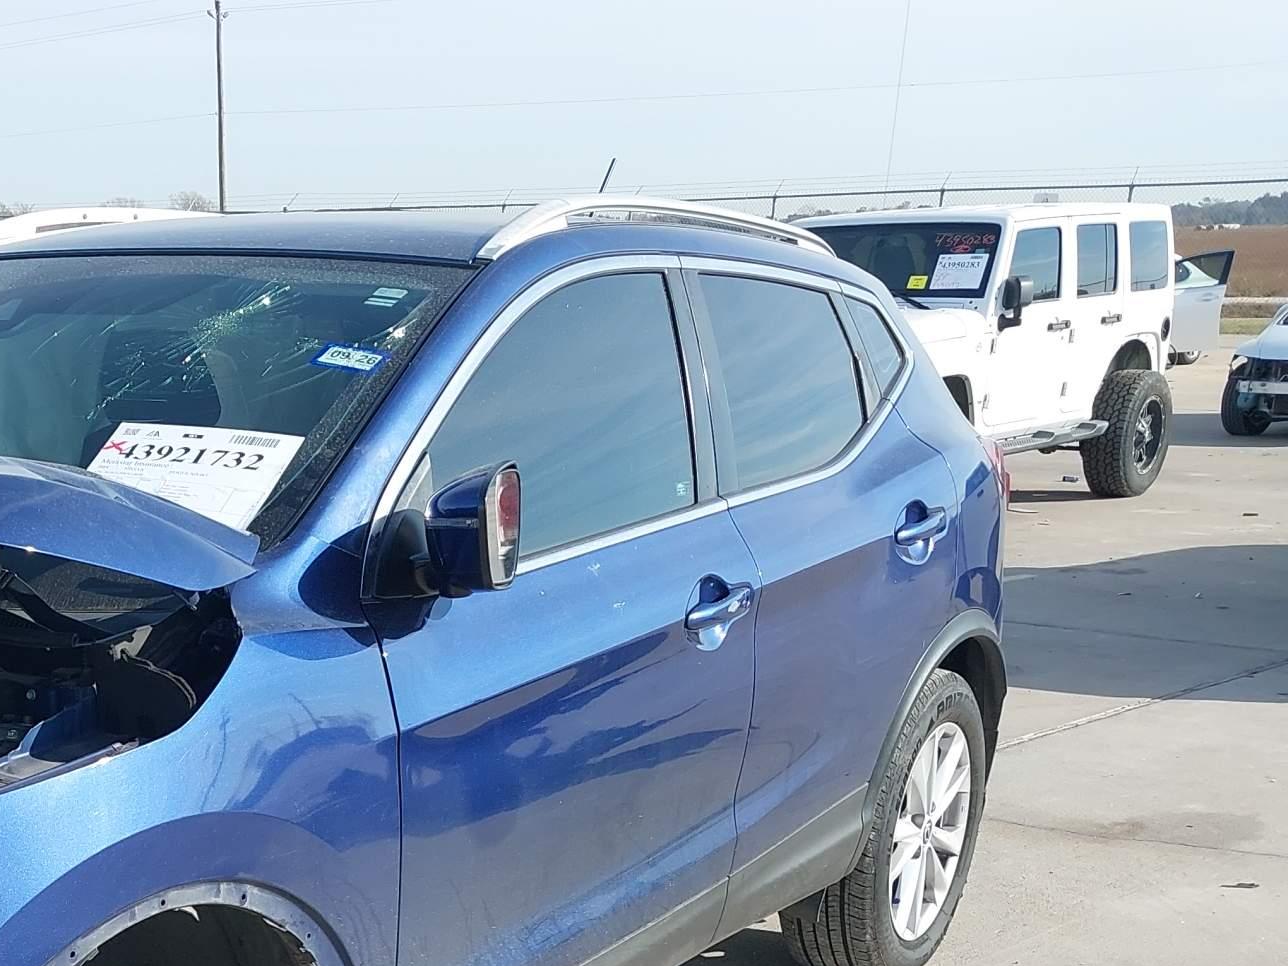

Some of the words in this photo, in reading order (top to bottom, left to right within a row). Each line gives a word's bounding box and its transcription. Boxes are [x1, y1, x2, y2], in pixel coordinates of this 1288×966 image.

[330, 350, 351, 360] 09
[355, 354, 378, 365] 26
[120, 443, 265, 471] 43921732
